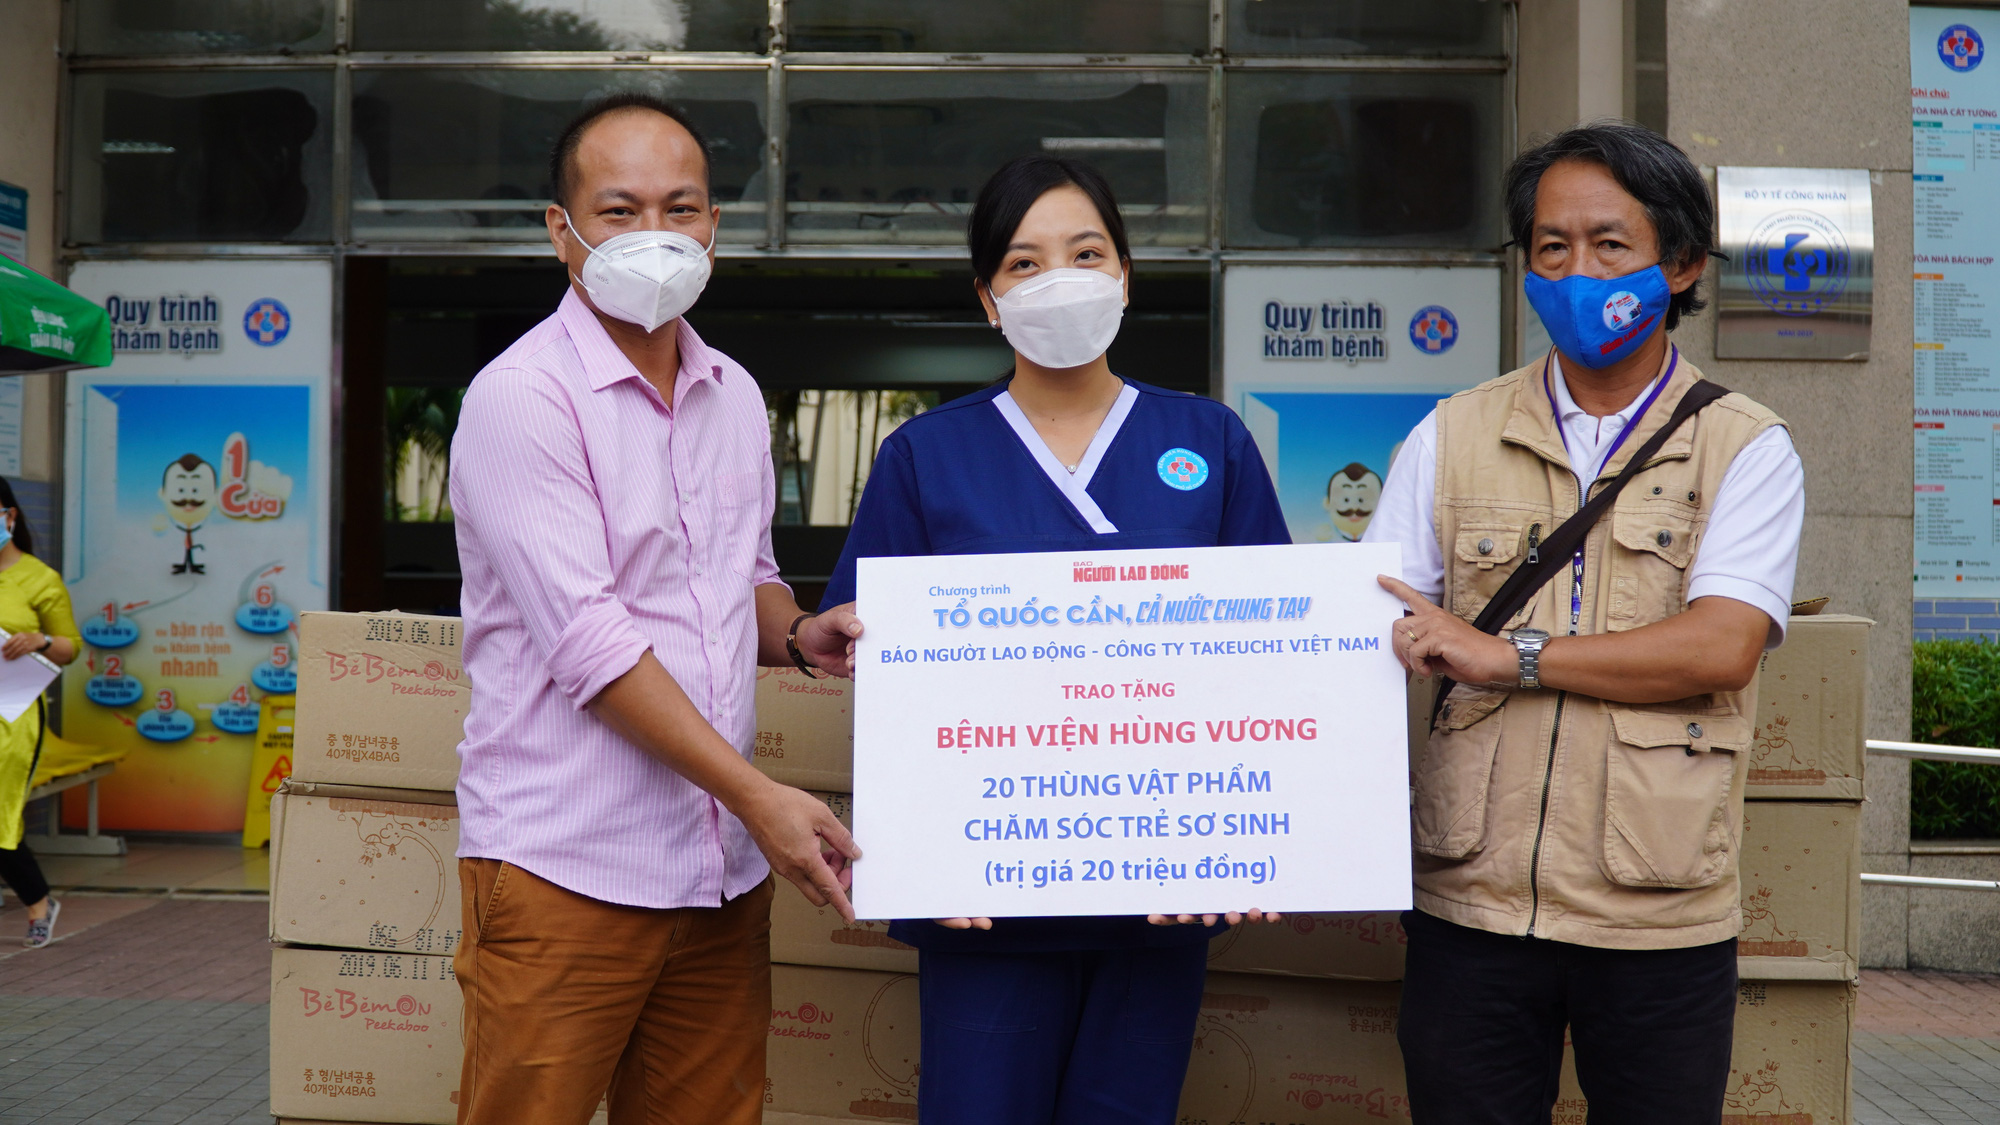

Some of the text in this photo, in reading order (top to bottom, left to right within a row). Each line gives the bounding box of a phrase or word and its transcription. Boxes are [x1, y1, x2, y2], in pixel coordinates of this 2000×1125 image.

[1930, 107, 1948, 116] NHÀ
[1761, 190, 1767, 199] Y
[1785, 190, 1814, 200] CÔNG
[1931, 254, 1950, 264] NHÀ
[106, 294, 216, 325] Quy trình
[1264, 300, 1382, 332] Quy trình
[168, 327, 218, 355] bệnh
[1264, 334, 1384, 362] khám bệnh
[1932, 407, 1950, 416] NHÀ
[226, 439, 246, 478] 1
[1074, 563, 1189, 583] NGƯỜI LAO ĐỘNG
[256, 586, 272, 604] 6
[929, 584, 1011, 598] Chương trình
[101, 602, 114, 624] 1
[933, 593, 1311, 628] TỔ QUỐC CẦN, CẢ NƯỚC CHUNG TAY
[366, 618, 454, 647] 2019.06.11
[273, 646, 288, 666] 5
[881, 645, 918, 663] BÁO
[924, 643, 986, 662] NGƯỜI
[993, 646, 1027, 660] LAO
[1032, 641, 1085, 662] ĐỘNG
[1105, 640, 1156, 657] CÔNG
[1161, 642, 1184, 656] TY
[1189, 640, 1283, 655] TAKEUCHI
[1289, 634, 1332, 655] VIỆT
[1338, 637, 1379, 651] NAM
[105, 656, 121, 676] 2
[161, 658, 218, 676] nhanh
[231, 684, 248, 704] 4
[391, 682, 456, 698] Peekaboo
[778, 680, 844, 696] Peekaboo
[1061, 679, 1175, 701] TRAO TẶNG
[158, 690, 173, 710] 3
[326, 734, 400, 750] 중 형/남녀공용
[938, 715, 1316, 754] BỆNH VIỆN HÙNG VƯƠNG
[326, 748, 400, 762] 40개입X4BAG
[982, 763, 1271, 801] 20 THÙNG VẬT PHẨM
[965, 808, 1289, 840] CHĂM SÓC TRẺ SƠ SINH
[985, 853, 1276, 888] (trị giá 20 triệu đồng)
[338, 954, 428, 980] 2019.06.11
[365, 1017, 430, 1032] Peekaboo
[304, 1068, 376, 1085] 중 형/남녀공용
[1289, 1072, 1358, 1088] Peekaboo
[304, 1084, 376, 1098] 40개입X4BAG
